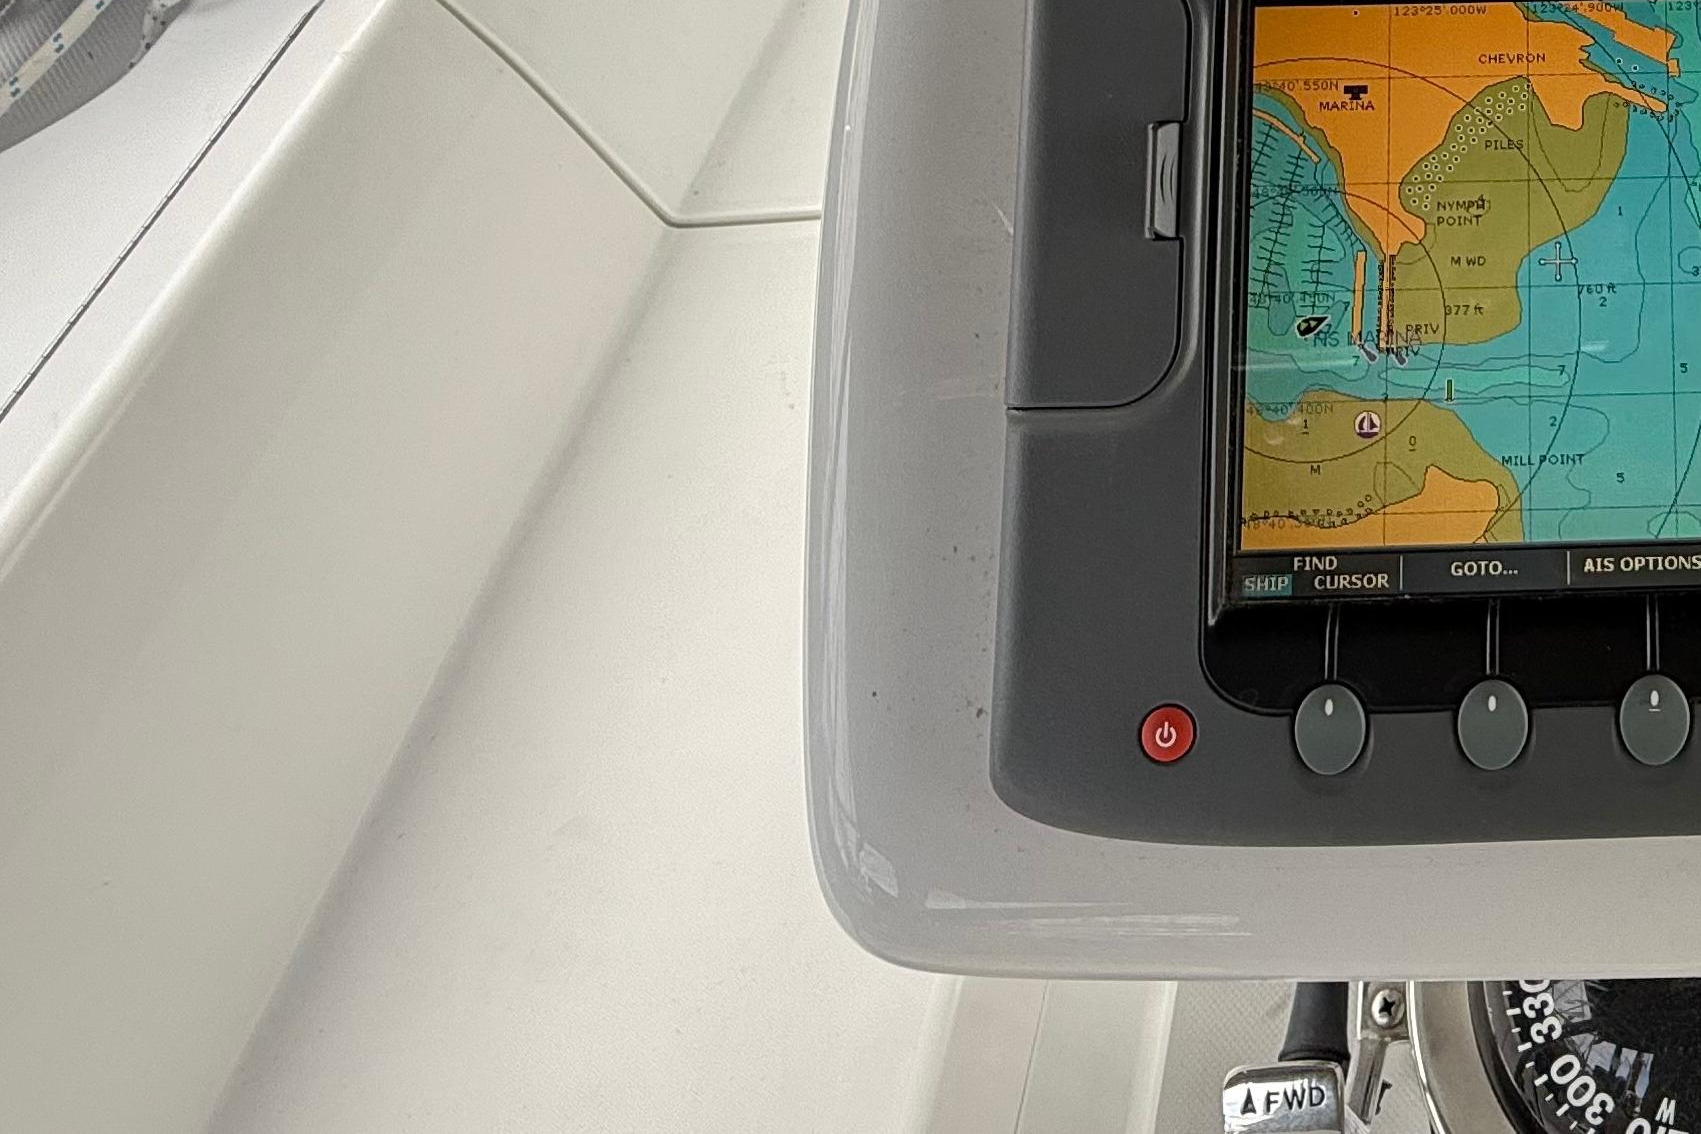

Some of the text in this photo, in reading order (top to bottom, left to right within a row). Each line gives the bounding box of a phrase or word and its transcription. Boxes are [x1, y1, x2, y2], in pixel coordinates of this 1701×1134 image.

[1478, 52, 1547, 64] CHEVRON
[1318, 100, 1375, 112] MARINA
[1484, 139, 1524, 151] PILES
[1436, 215, 1482, 227] POINT
[1501, 455, 1534, 466] MILL
[1292, 554, 1338, 572] FIND
[1450, 559, 1520, 578] GOTO...
[1583, 557, 1616, 574] AIS
[1244, 572, 1391, 593] SHIP CURSOR
[1264, 1084, 1327, 1114] FWD
[1550, 1054, 1616, 1127] 300
